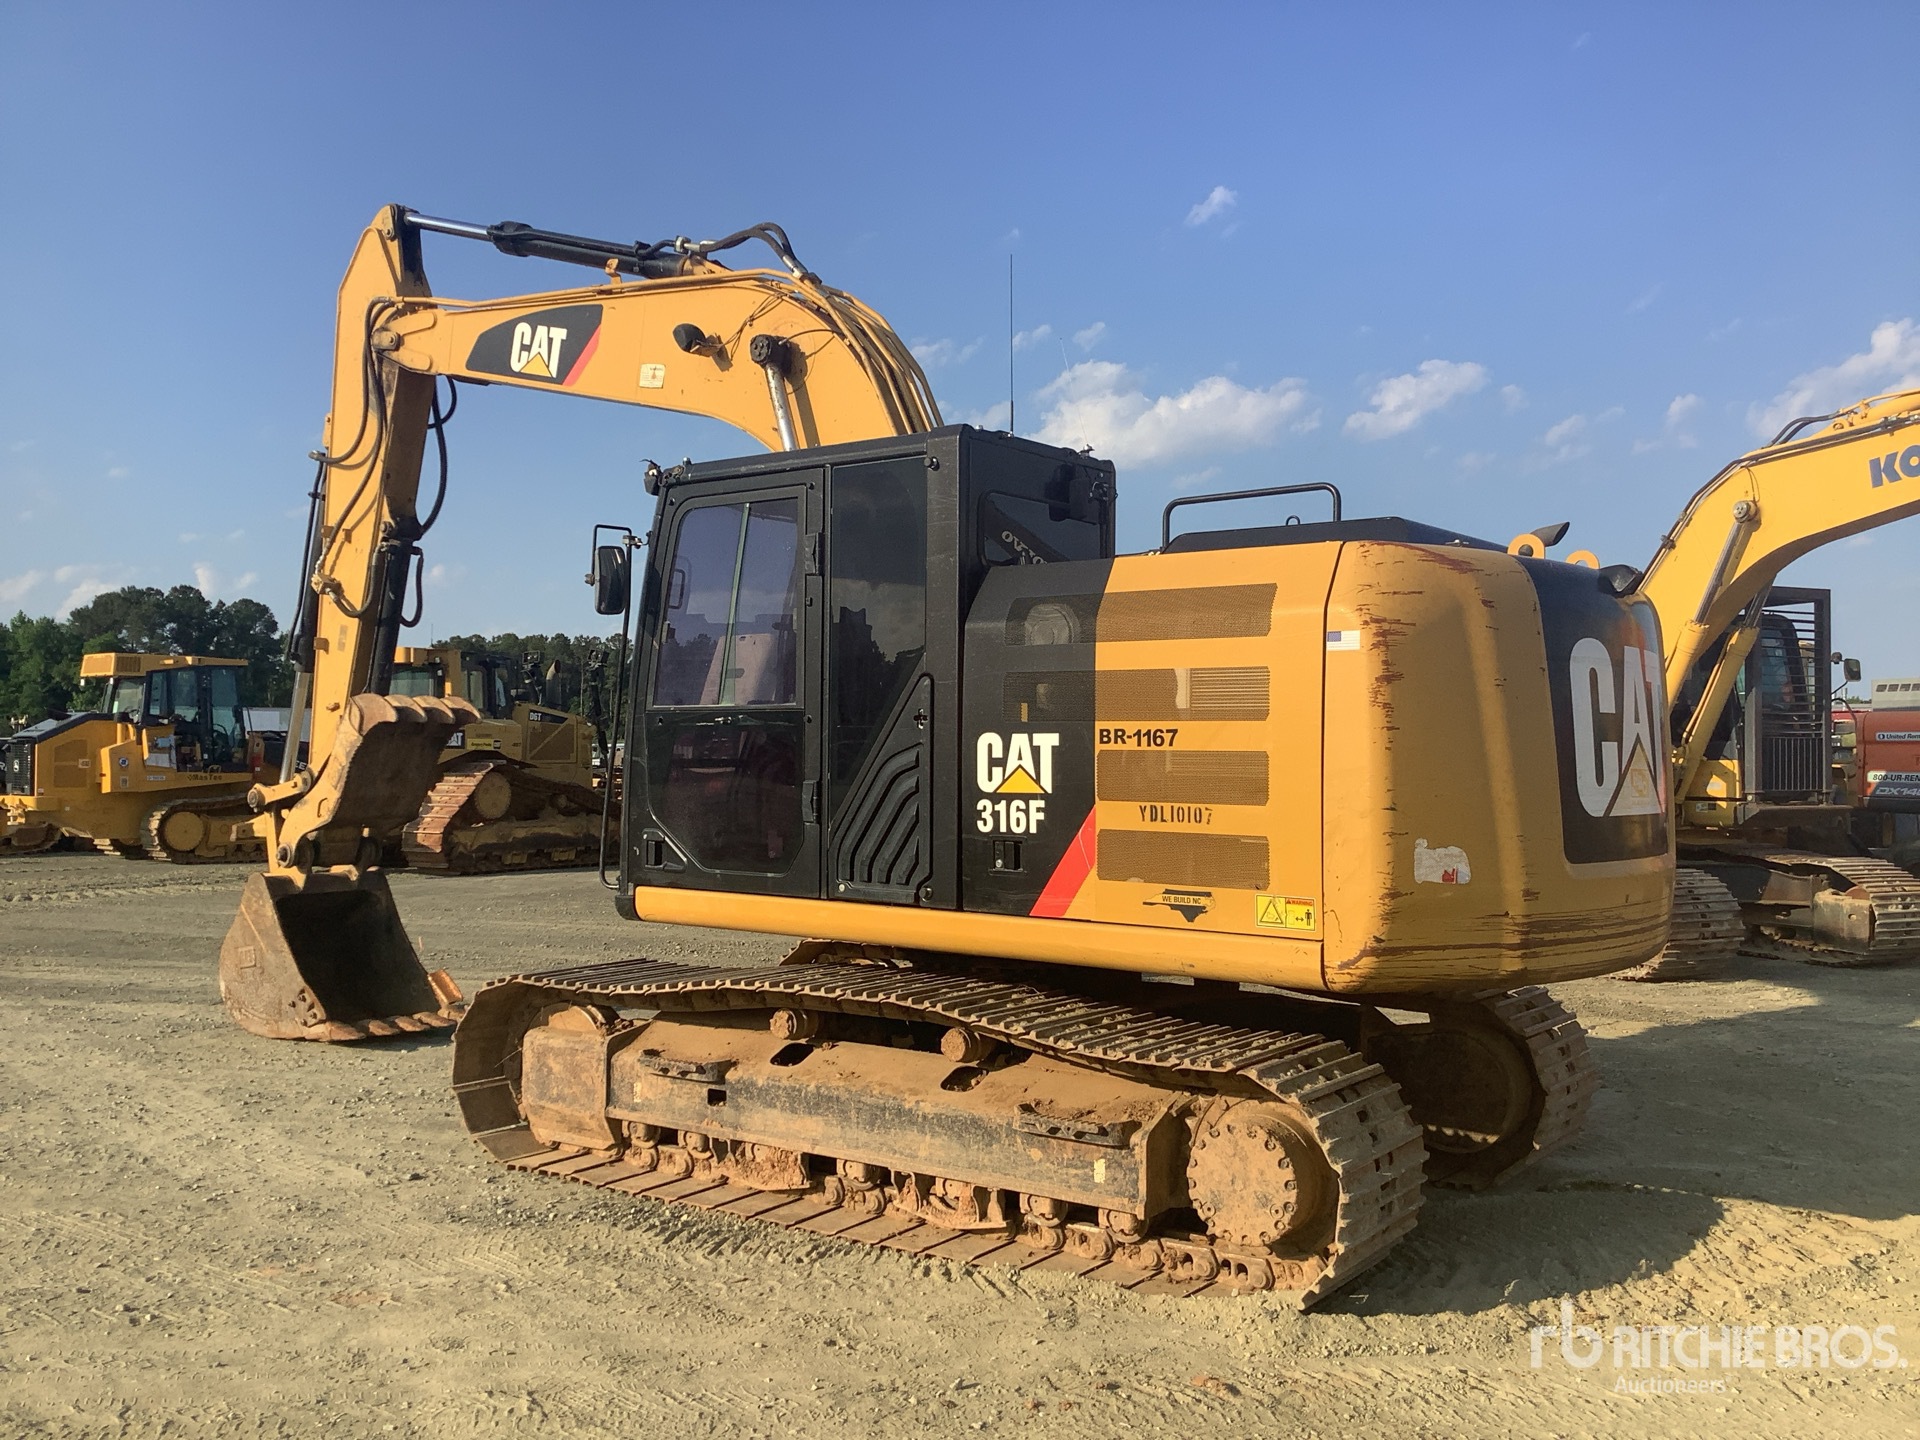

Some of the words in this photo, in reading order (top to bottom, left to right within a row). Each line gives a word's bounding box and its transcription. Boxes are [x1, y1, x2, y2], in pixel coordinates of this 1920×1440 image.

[510, 322, 567, 378] CAT
[1869, 445, 1920, 488] KO
[446, 732, 463, 747] AT
[1099, 728, 1178, 747] BR-1167
[1569, 637, 1665, 818] CAT
[977, 732, 1059, 794] CAT
[977, 799, 1045, 834] 316F
[1162, 895, 1173, 903] WE
[1173, 896, 1191, 904] BUILD
[1192, 897, 1202, 905] NC
